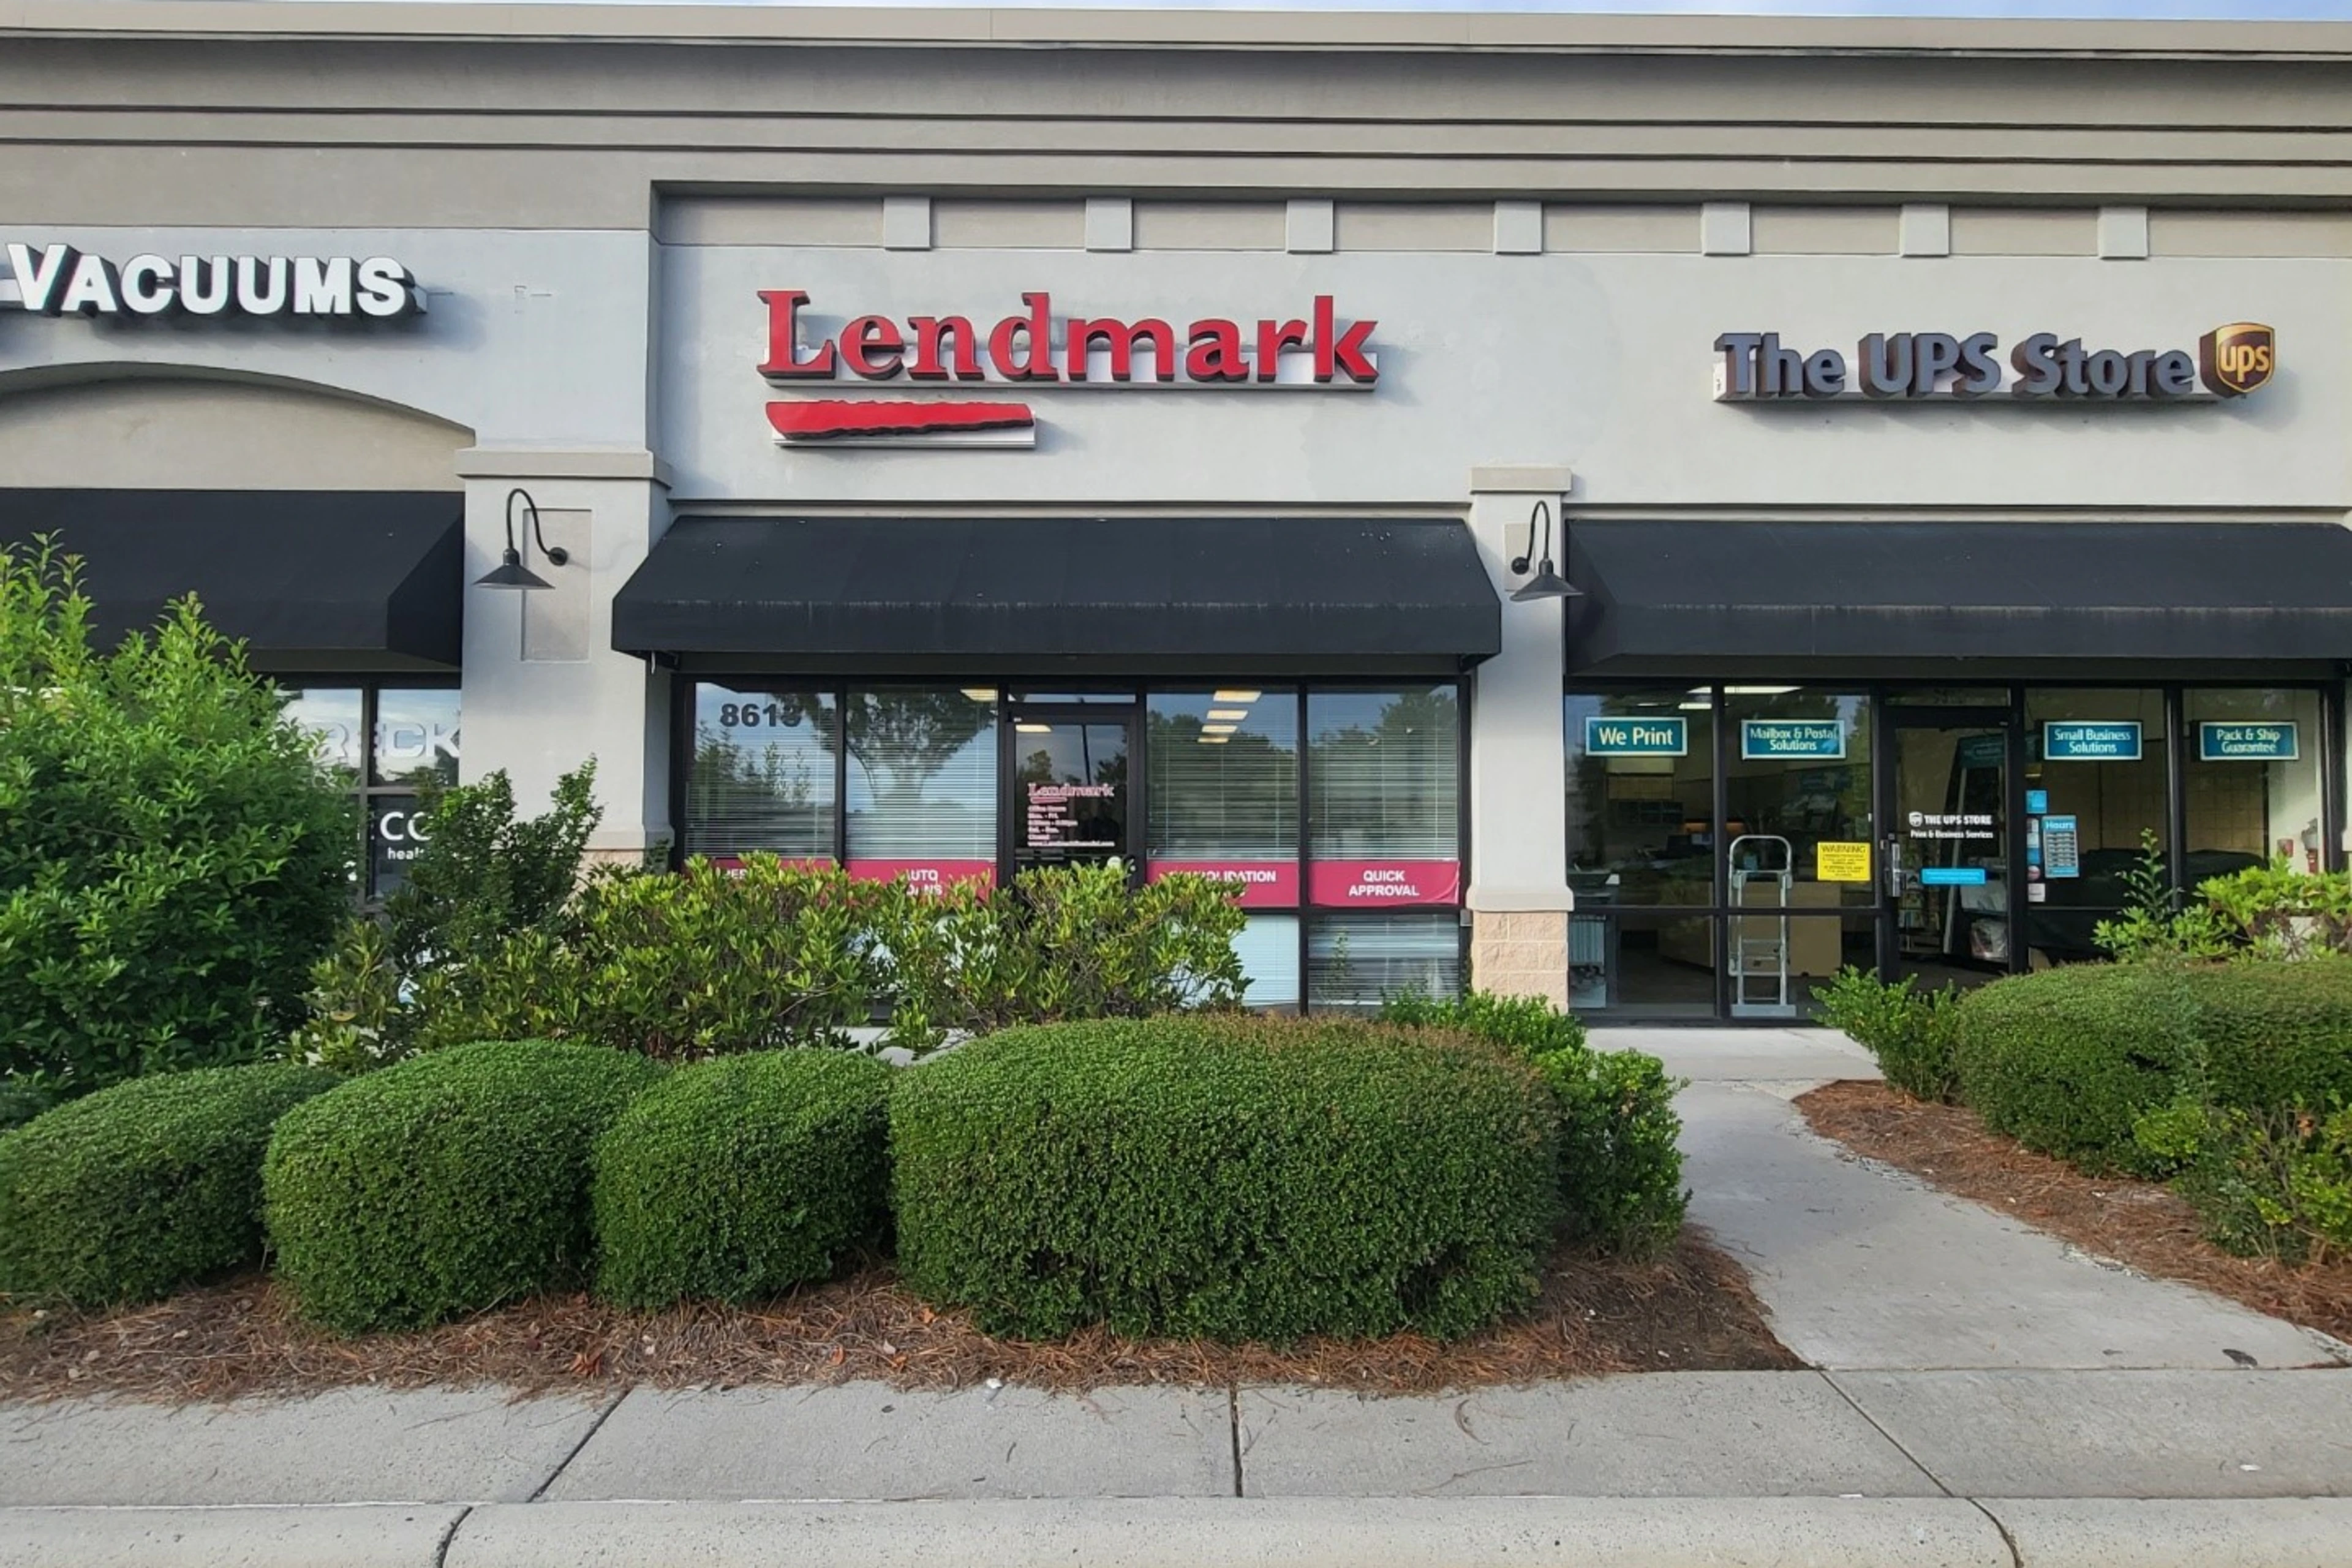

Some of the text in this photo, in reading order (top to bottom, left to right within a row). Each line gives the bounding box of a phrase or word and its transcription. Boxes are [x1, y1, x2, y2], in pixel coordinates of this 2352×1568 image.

[9, 244, 415, 317] VACUUMS
[757, 290, 1379, 383] Lendmark
[1717, 331, 2195, 398] The UPS Store
[2218, 342, 2271, 383] ups
[1598, 726, 1674, 746] We Print
[1750, 727, 1838, 739] Mailbox & Postal
[2054, 728, 2131, 741] Small Business
[2216, 728, 2281, 743] Pack & Ship
[1770, 739, 1817, 751] Solutions
[2068, 741, 2117, 753] Solutions
[2221, 741, 2277, 753] Guarantee
[1027, 782, 1115, 797] Lendmark
[1924, 815, 1942, 825] THE
[1943, 815, 1962, 825] UPS
[1963, 815, 1993, 825] STORE
[1363, 870, 1406, 882] QUICK
[1348, 884, 1420, 896] APPROVAL
